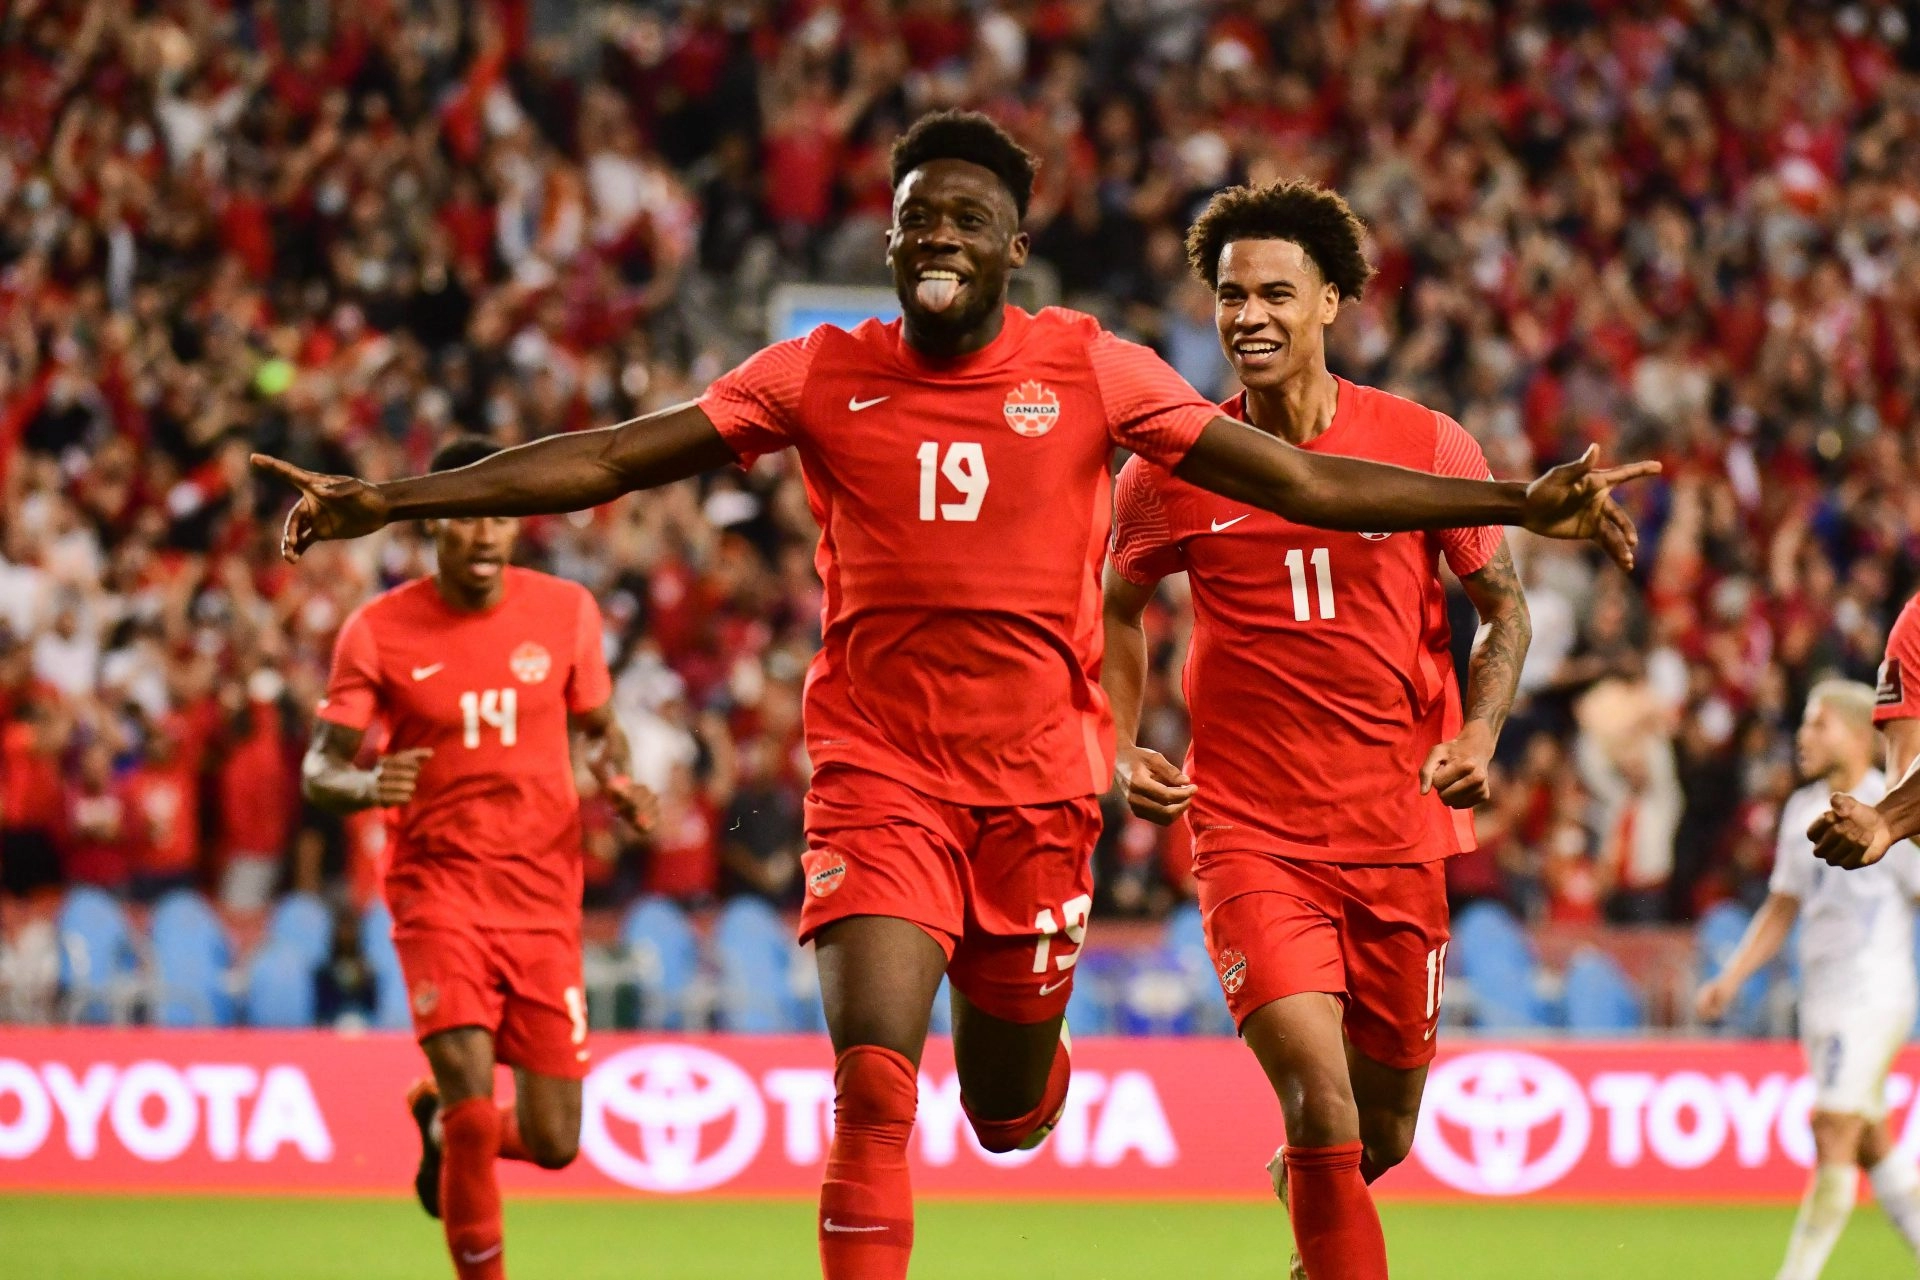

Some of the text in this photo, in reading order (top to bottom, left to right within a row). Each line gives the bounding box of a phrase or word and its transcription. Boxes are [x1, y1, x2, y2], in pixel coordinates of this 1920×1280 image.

[1005, 406, 1056, 414] CANADA
[916, 441, 990, 521] 19
[1284, 547, 1335, 621] 11
[460, 687, 517, 750] 14
[1032, 893, 1092, 973] 19
[1223, 962, 1245, 981] CANADA
[563, 986, 588, 1046] 1
[1426, 941, 1449, 1020] 11
[0, 1057, 335, 1163] OYOTA
[763, 1067, 1180, 1168] TYTA
[1589, 1069, 1920, 1170] TOY
